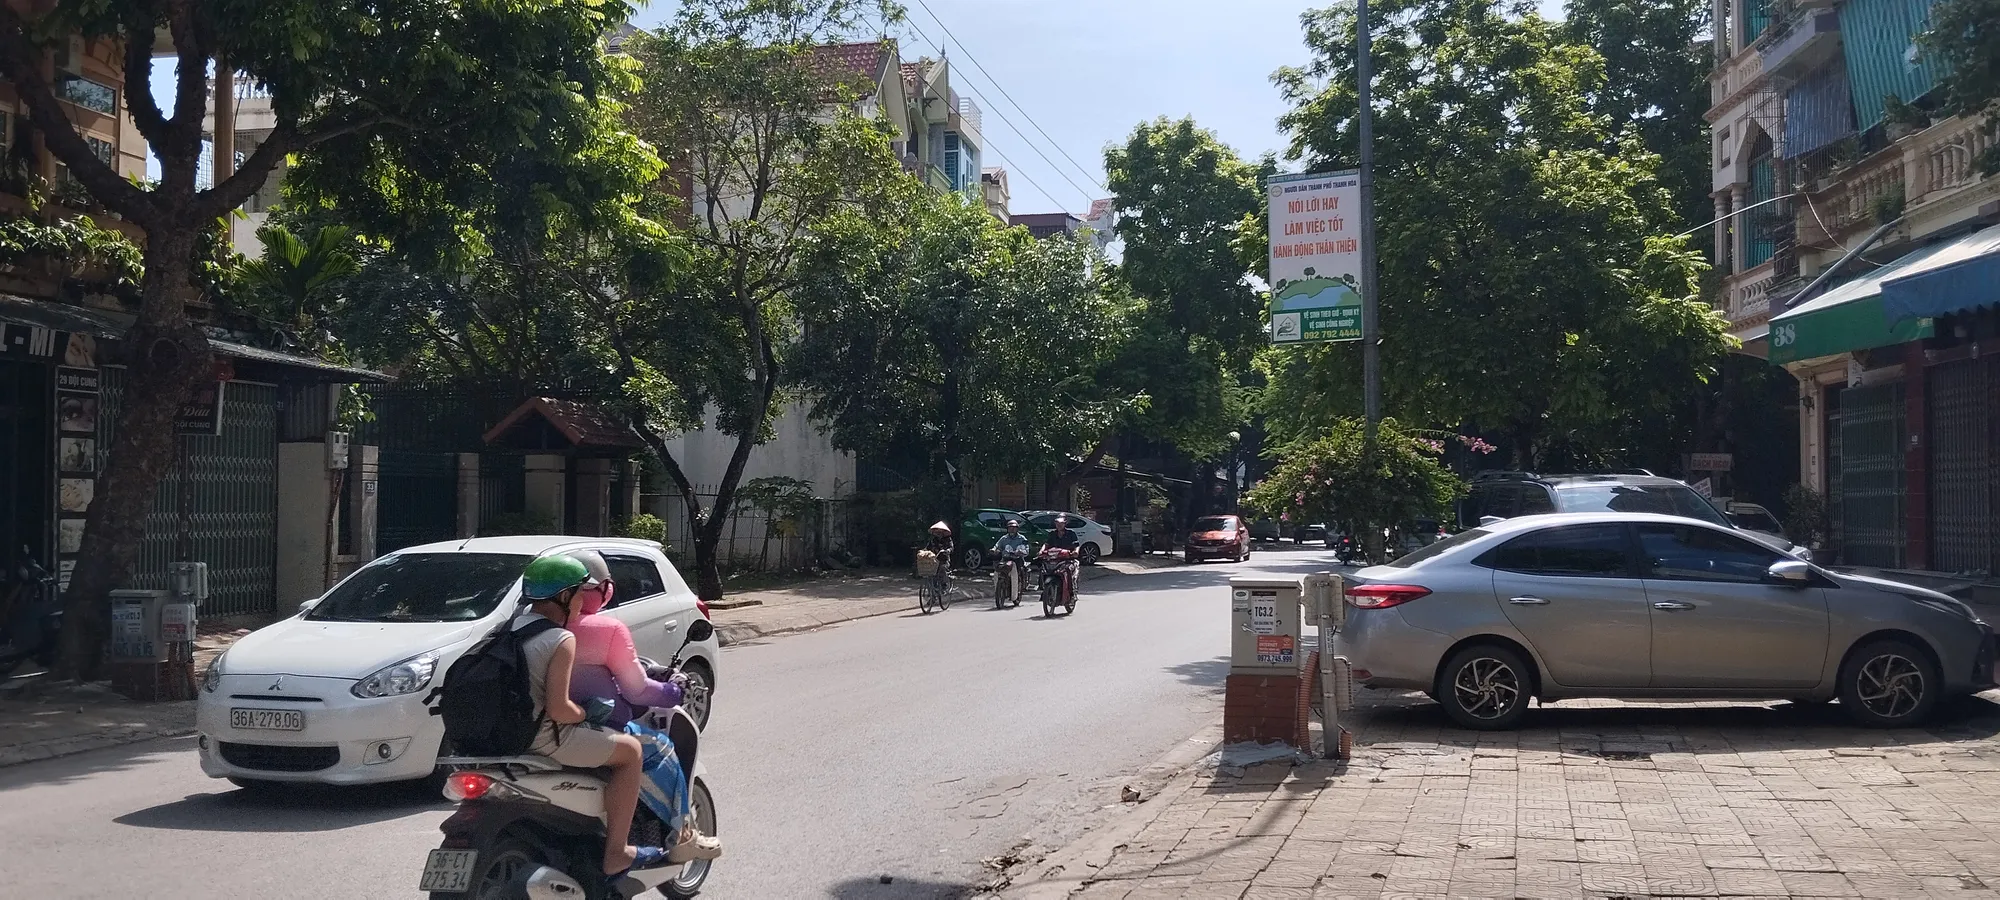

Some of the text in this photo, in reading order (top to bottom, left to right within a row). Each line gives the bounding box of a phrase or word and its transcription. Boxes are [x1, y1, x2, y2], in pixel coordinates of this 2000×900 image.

[1288, 196, 1339, 213] NÓI LỜI HAY
[1284, 214, 1344, 236] LÀM VIỆC TỐT
[1273, 237, 1357, 259] HÀNH ĐỘNG THÂN THIỆN
[29, 326, 56, 357] MI
[1304, 331, 1320, 340] 092
[1321, 330, 1337, 338] 792
[1339, 328, 1360, 337] 4444
[1774, 323, 1796, 347] 38
[59, 374, 67, 385] 29
[80, 377, 97, 387] CUNG
[1254, 606, 1273, 617] TC3.2
[433, 852, 469, 869] 36-C1
[422, 871, 467, 888] 275.34
